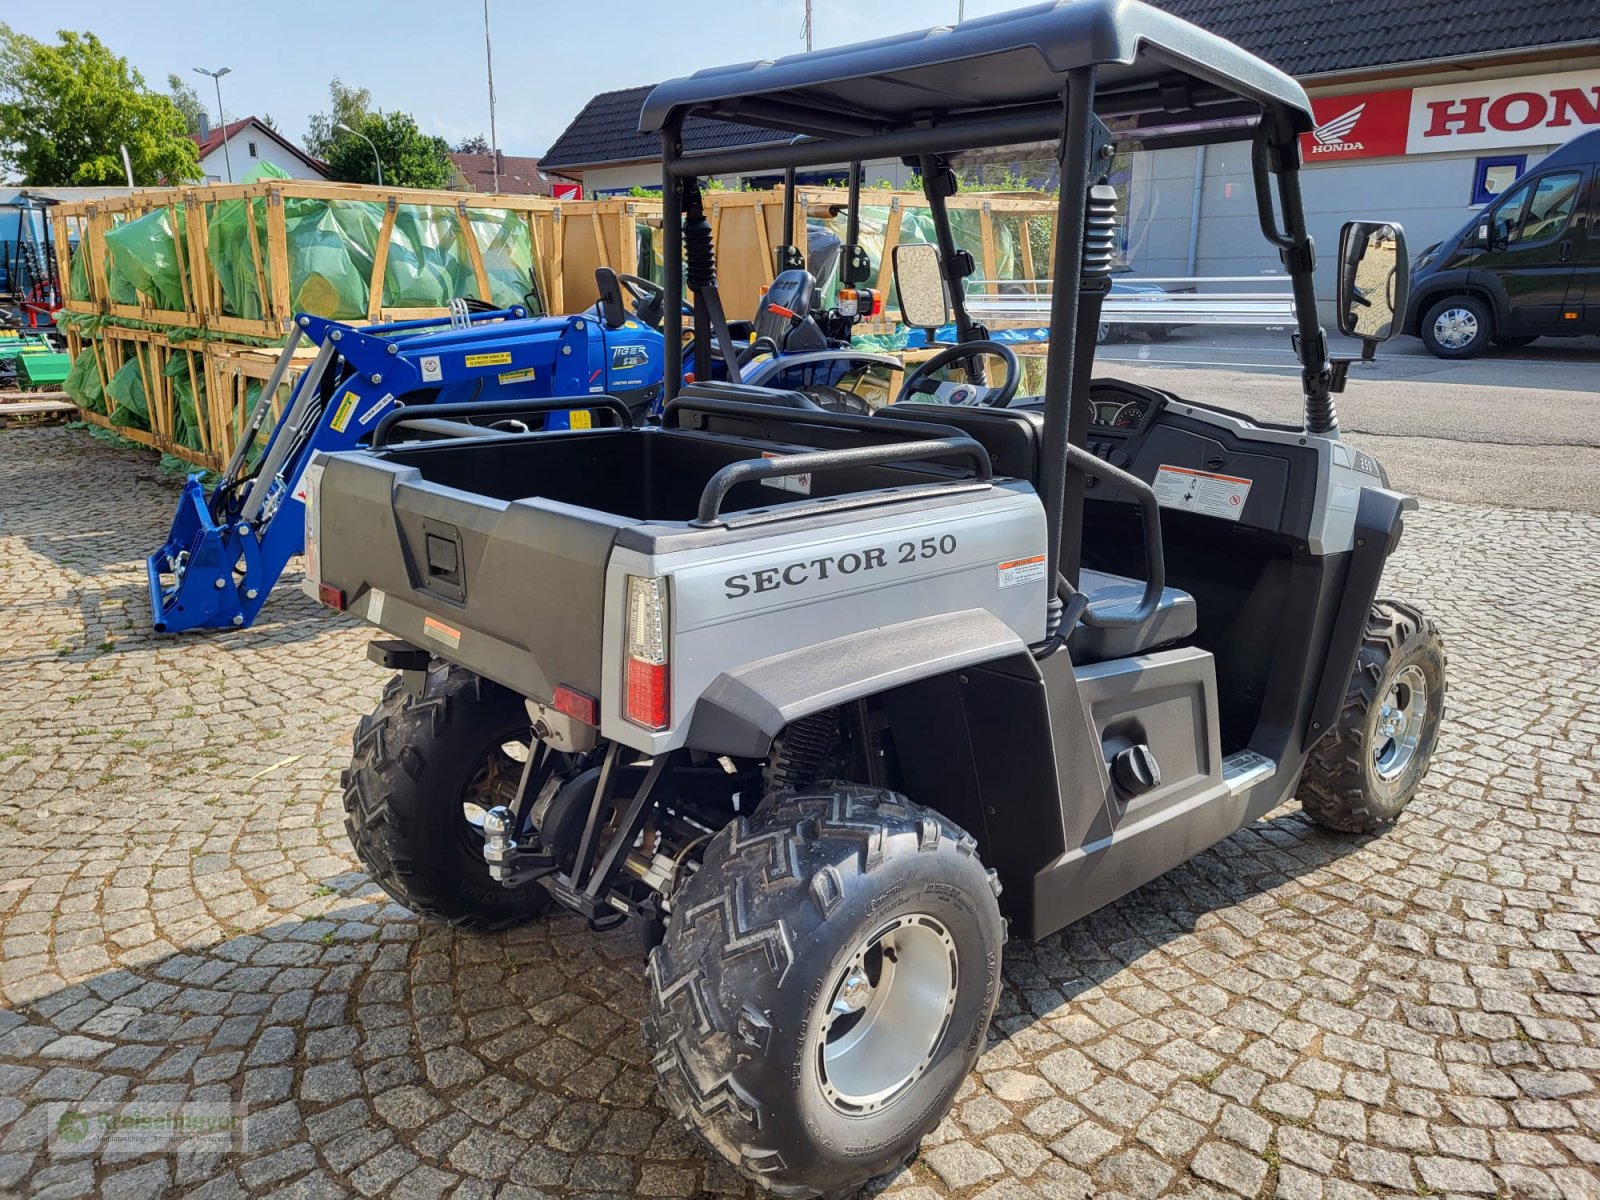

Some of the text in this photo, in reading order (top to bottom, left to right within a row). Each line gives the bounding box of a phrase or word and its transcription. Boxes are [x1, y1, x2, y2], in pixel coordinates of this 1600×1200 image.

[1311, 141, 1364, 154] HONDA
[610, 345, 649, 360] TIGER
[724, 534, 958, 600] SECTOR 250
